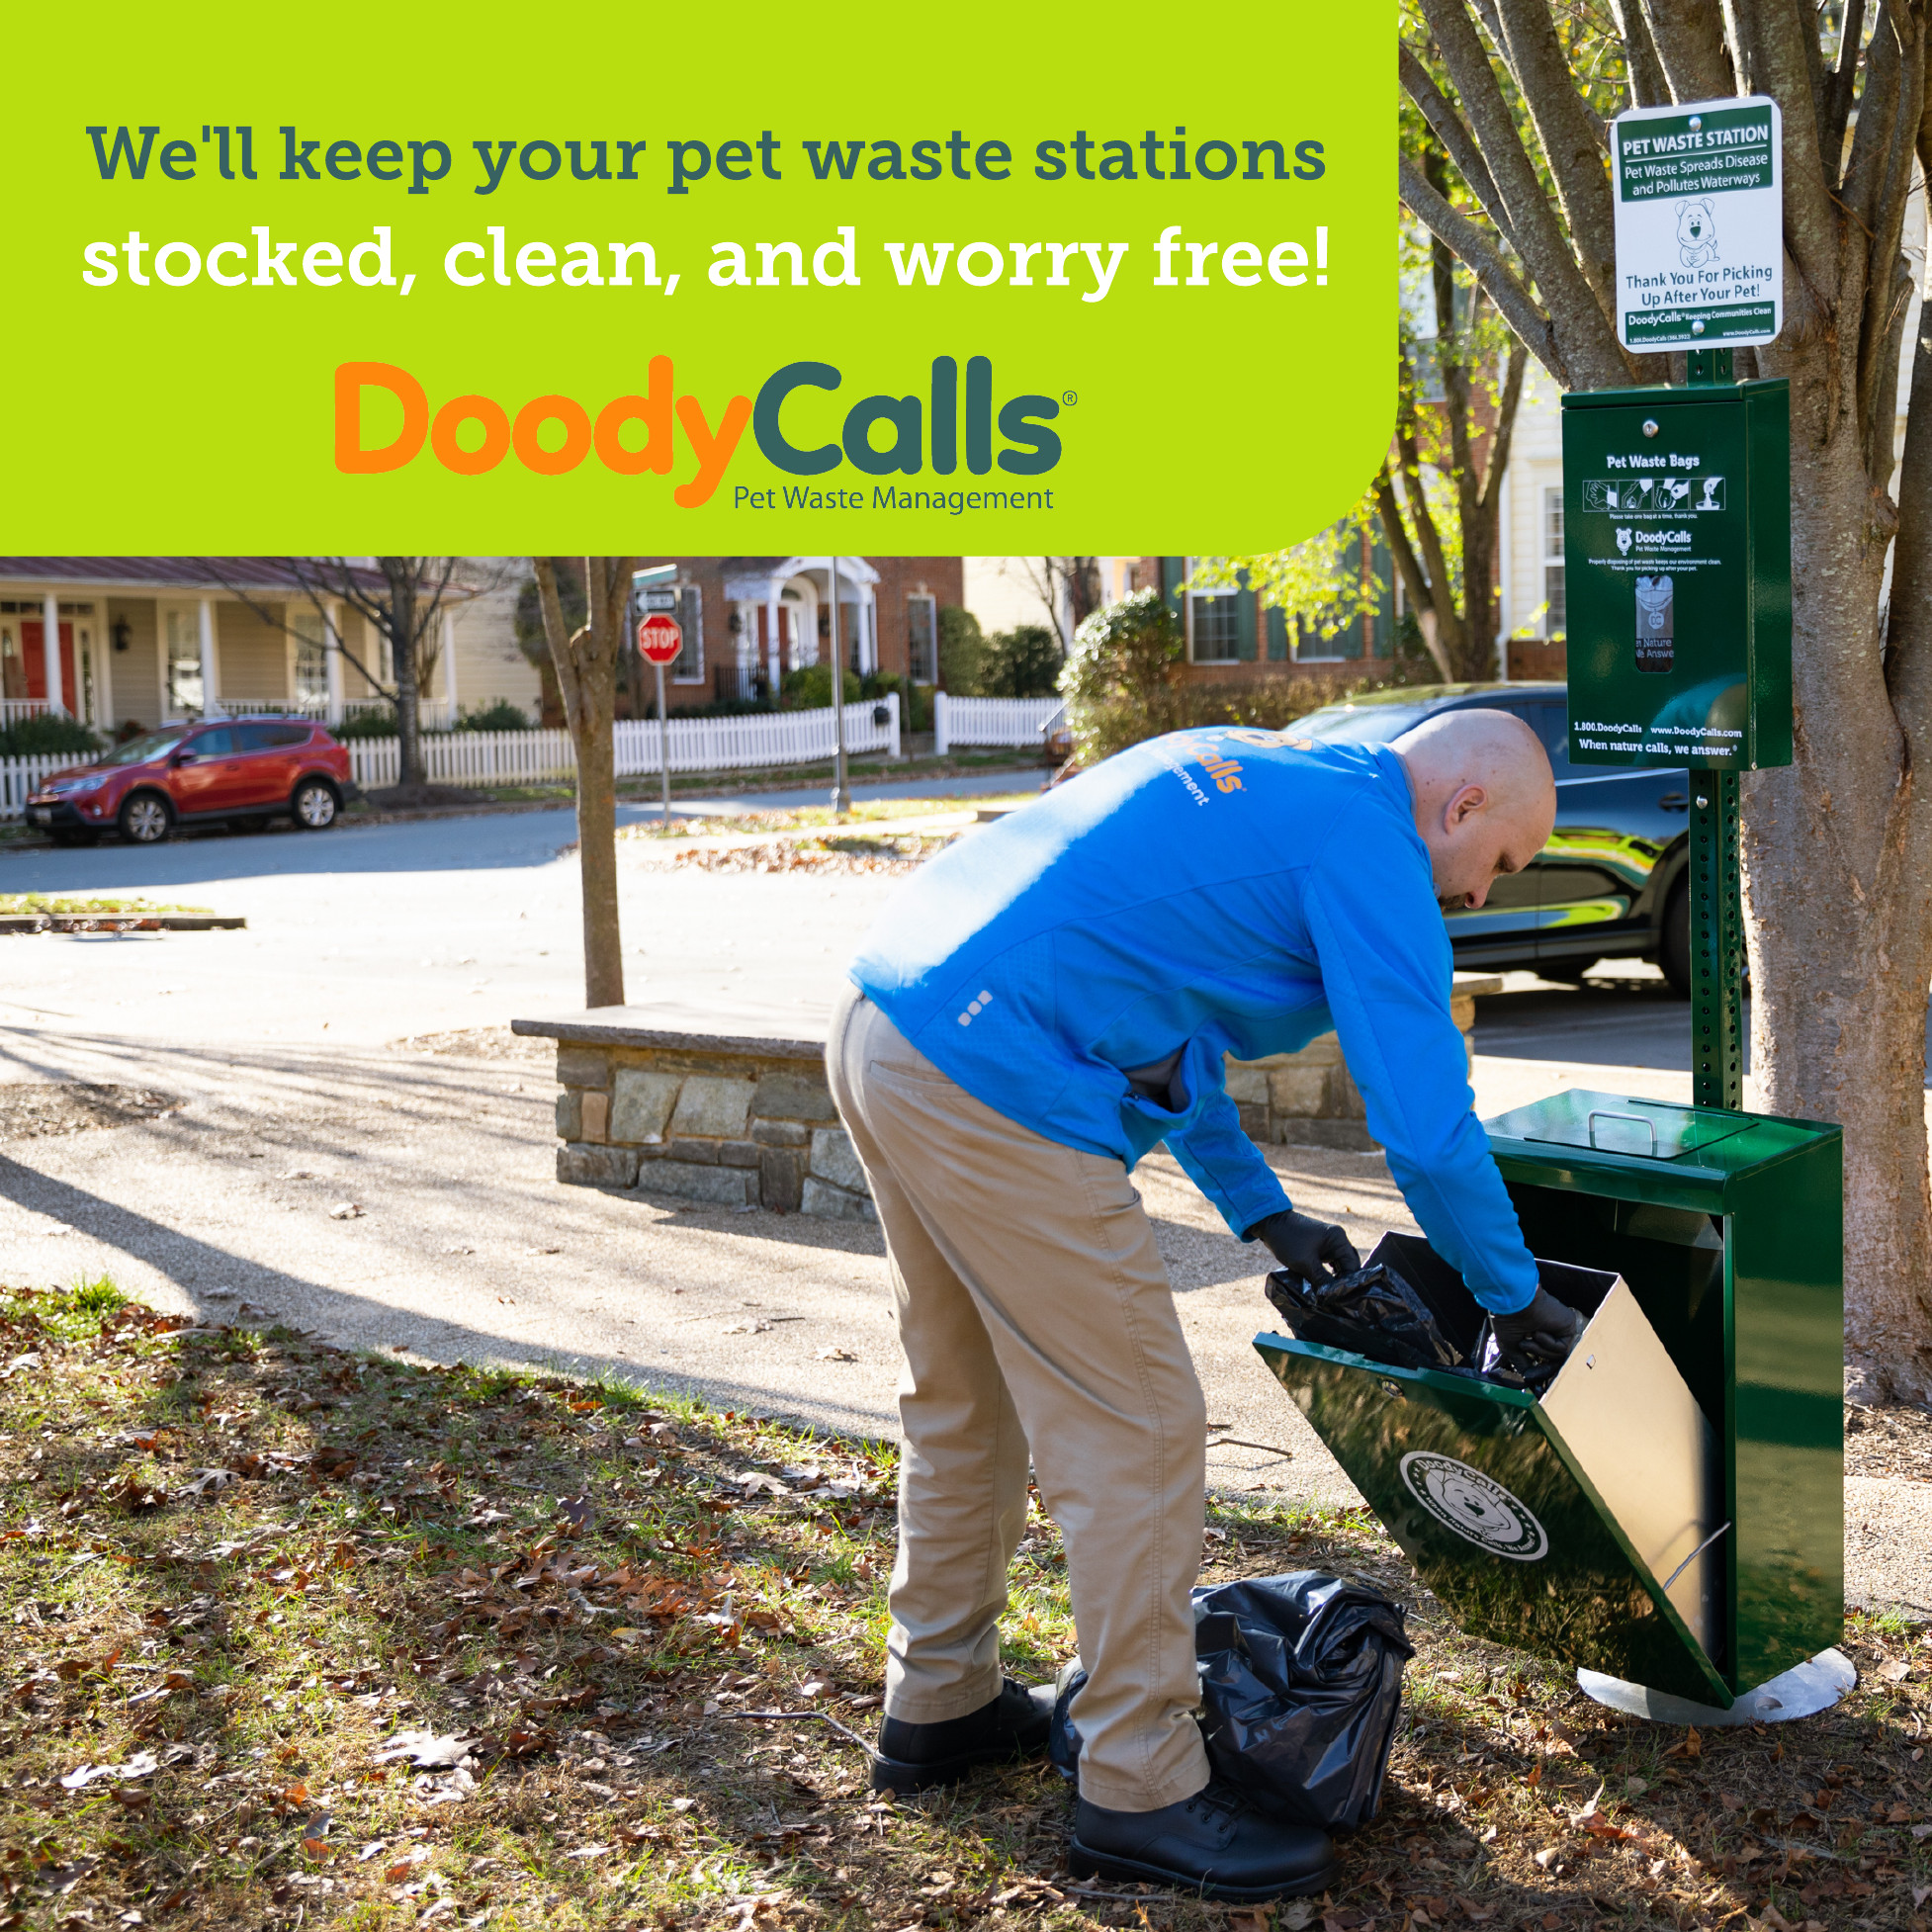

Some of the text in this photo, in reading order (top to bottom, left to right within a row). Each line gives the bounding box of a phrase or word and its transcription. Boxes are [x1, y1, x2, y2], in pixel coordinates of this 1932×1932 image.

[1623, 125, 1768, 156] PET WASTE STATION
[1625, 153, 1768, 179] Pet Waste Spreads Disease
[1632, 172, 1761, 196] and Pollutes Waterways
[1625, 265, 1773, 289] Thank You For Picking
[1641, 284, 1760, 307] Up After Your Pet!
[1685, 311, 1712, 321] Keeping
[1712, 309, 1753, 319] Communities
[1753, 307, 1772, 315] Clean
[1607, 454, 1700, 470] Pet Waste Bags
[1635, 530, 1692, 546] DoodyCalls
[642, 626, 679, 650] STOP
[1643, 638, 1672, 648] Nature
[1574, 721, 1743, 739] 1.800.DoodyCalls www.DoodyCalls.com
[1579, 739, 1609, 751] When
[1610, 741, 1643, 752] nature
[1645, 743, 1672, 755] calls,
[1674, 745, 1689, 755] we
